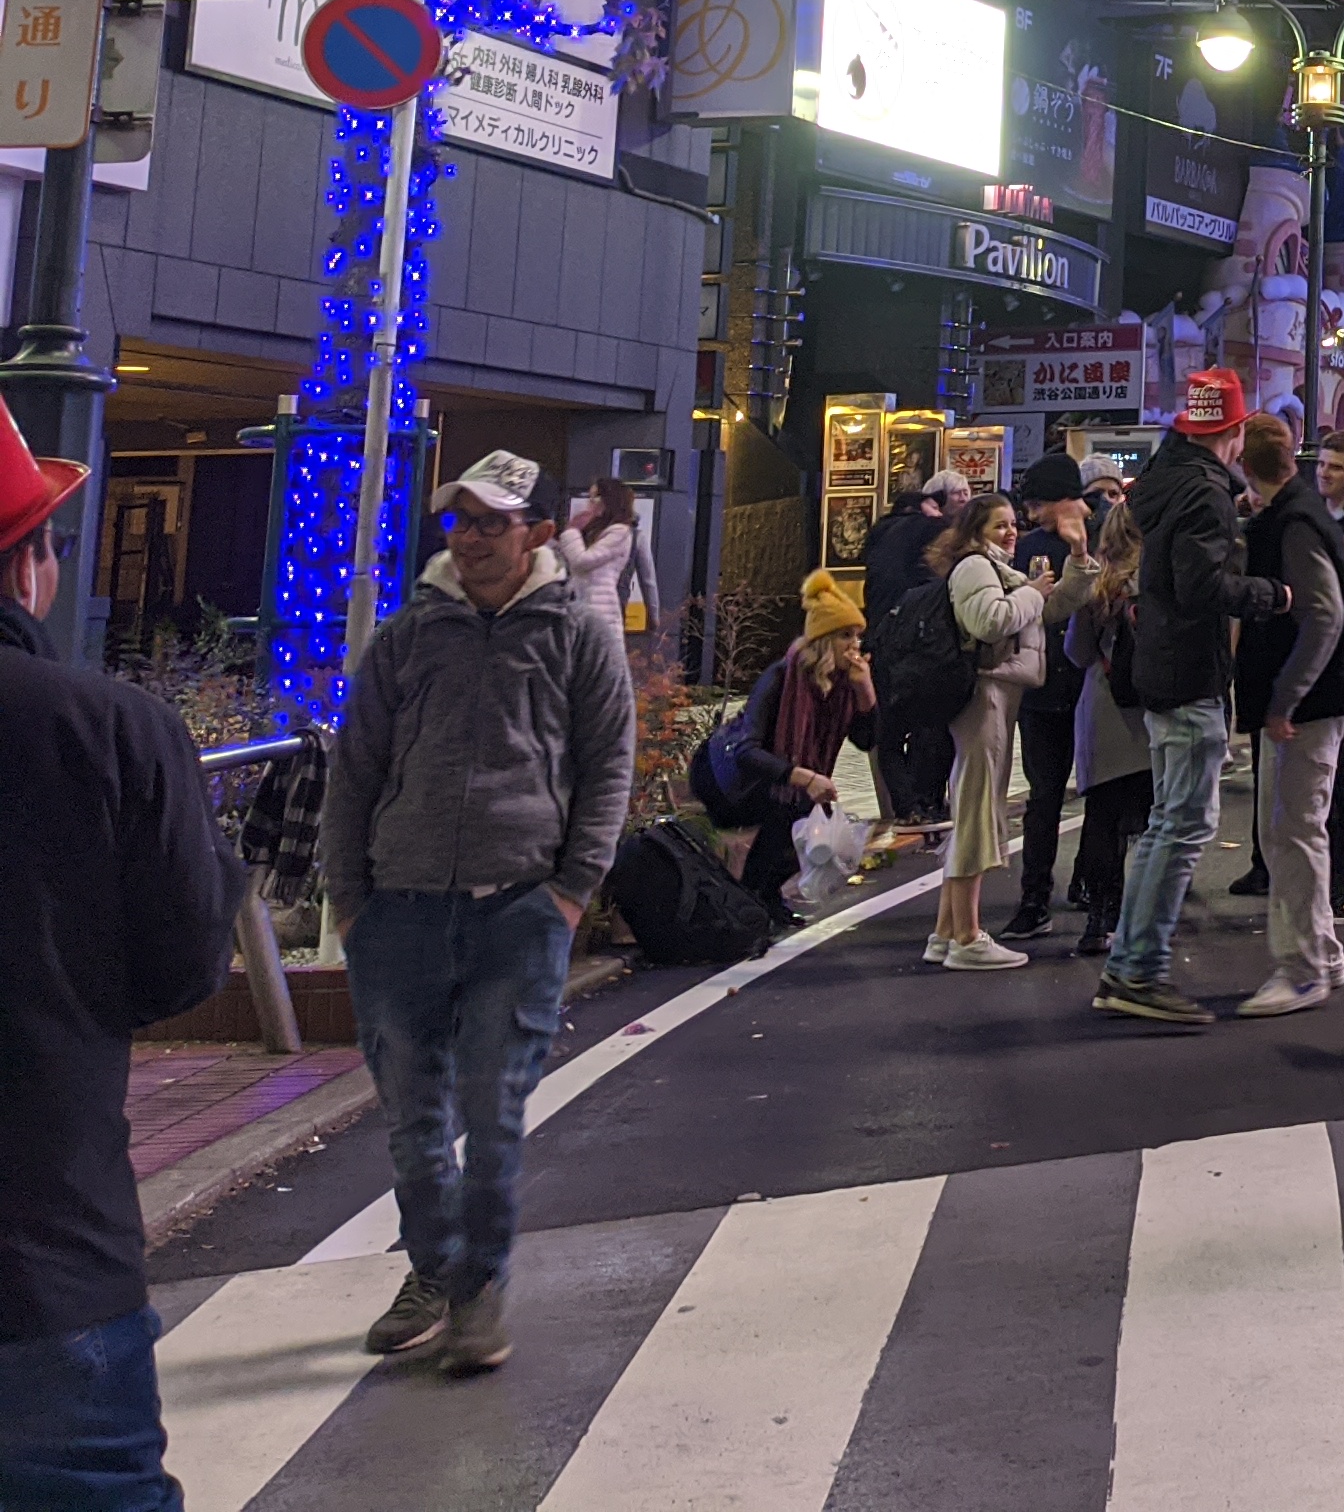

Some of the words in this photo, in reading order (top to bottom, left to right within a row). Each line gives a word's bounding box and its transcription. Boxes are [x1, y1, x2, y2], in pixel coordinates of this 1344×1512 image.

[1015, 6, 1033, 31] 8F
[473, 45, 497, 71] 内科
[499, 53, 523, 79] 外科
[525, 61, 559, 91] 婦人科
[561, 73, 604, 105] 乳腺外科
[1155, 54, 1173, 80] 7F
[470, 71, 517, 103] 健康診断
[519, 87, 575, 119] 人間ドック
[1033, 83, 1074, 123] 鍋ぞう
[448, 104, 599, 165] マイメディカルクリニック
[960, 221, 1069, 289] Pavilion
[1045, 331, 1113, 349] 入口案内
[1033, 385, 1128, 401] 渋谷公園通り店
[1190, 407, 1222, 418] 2020
